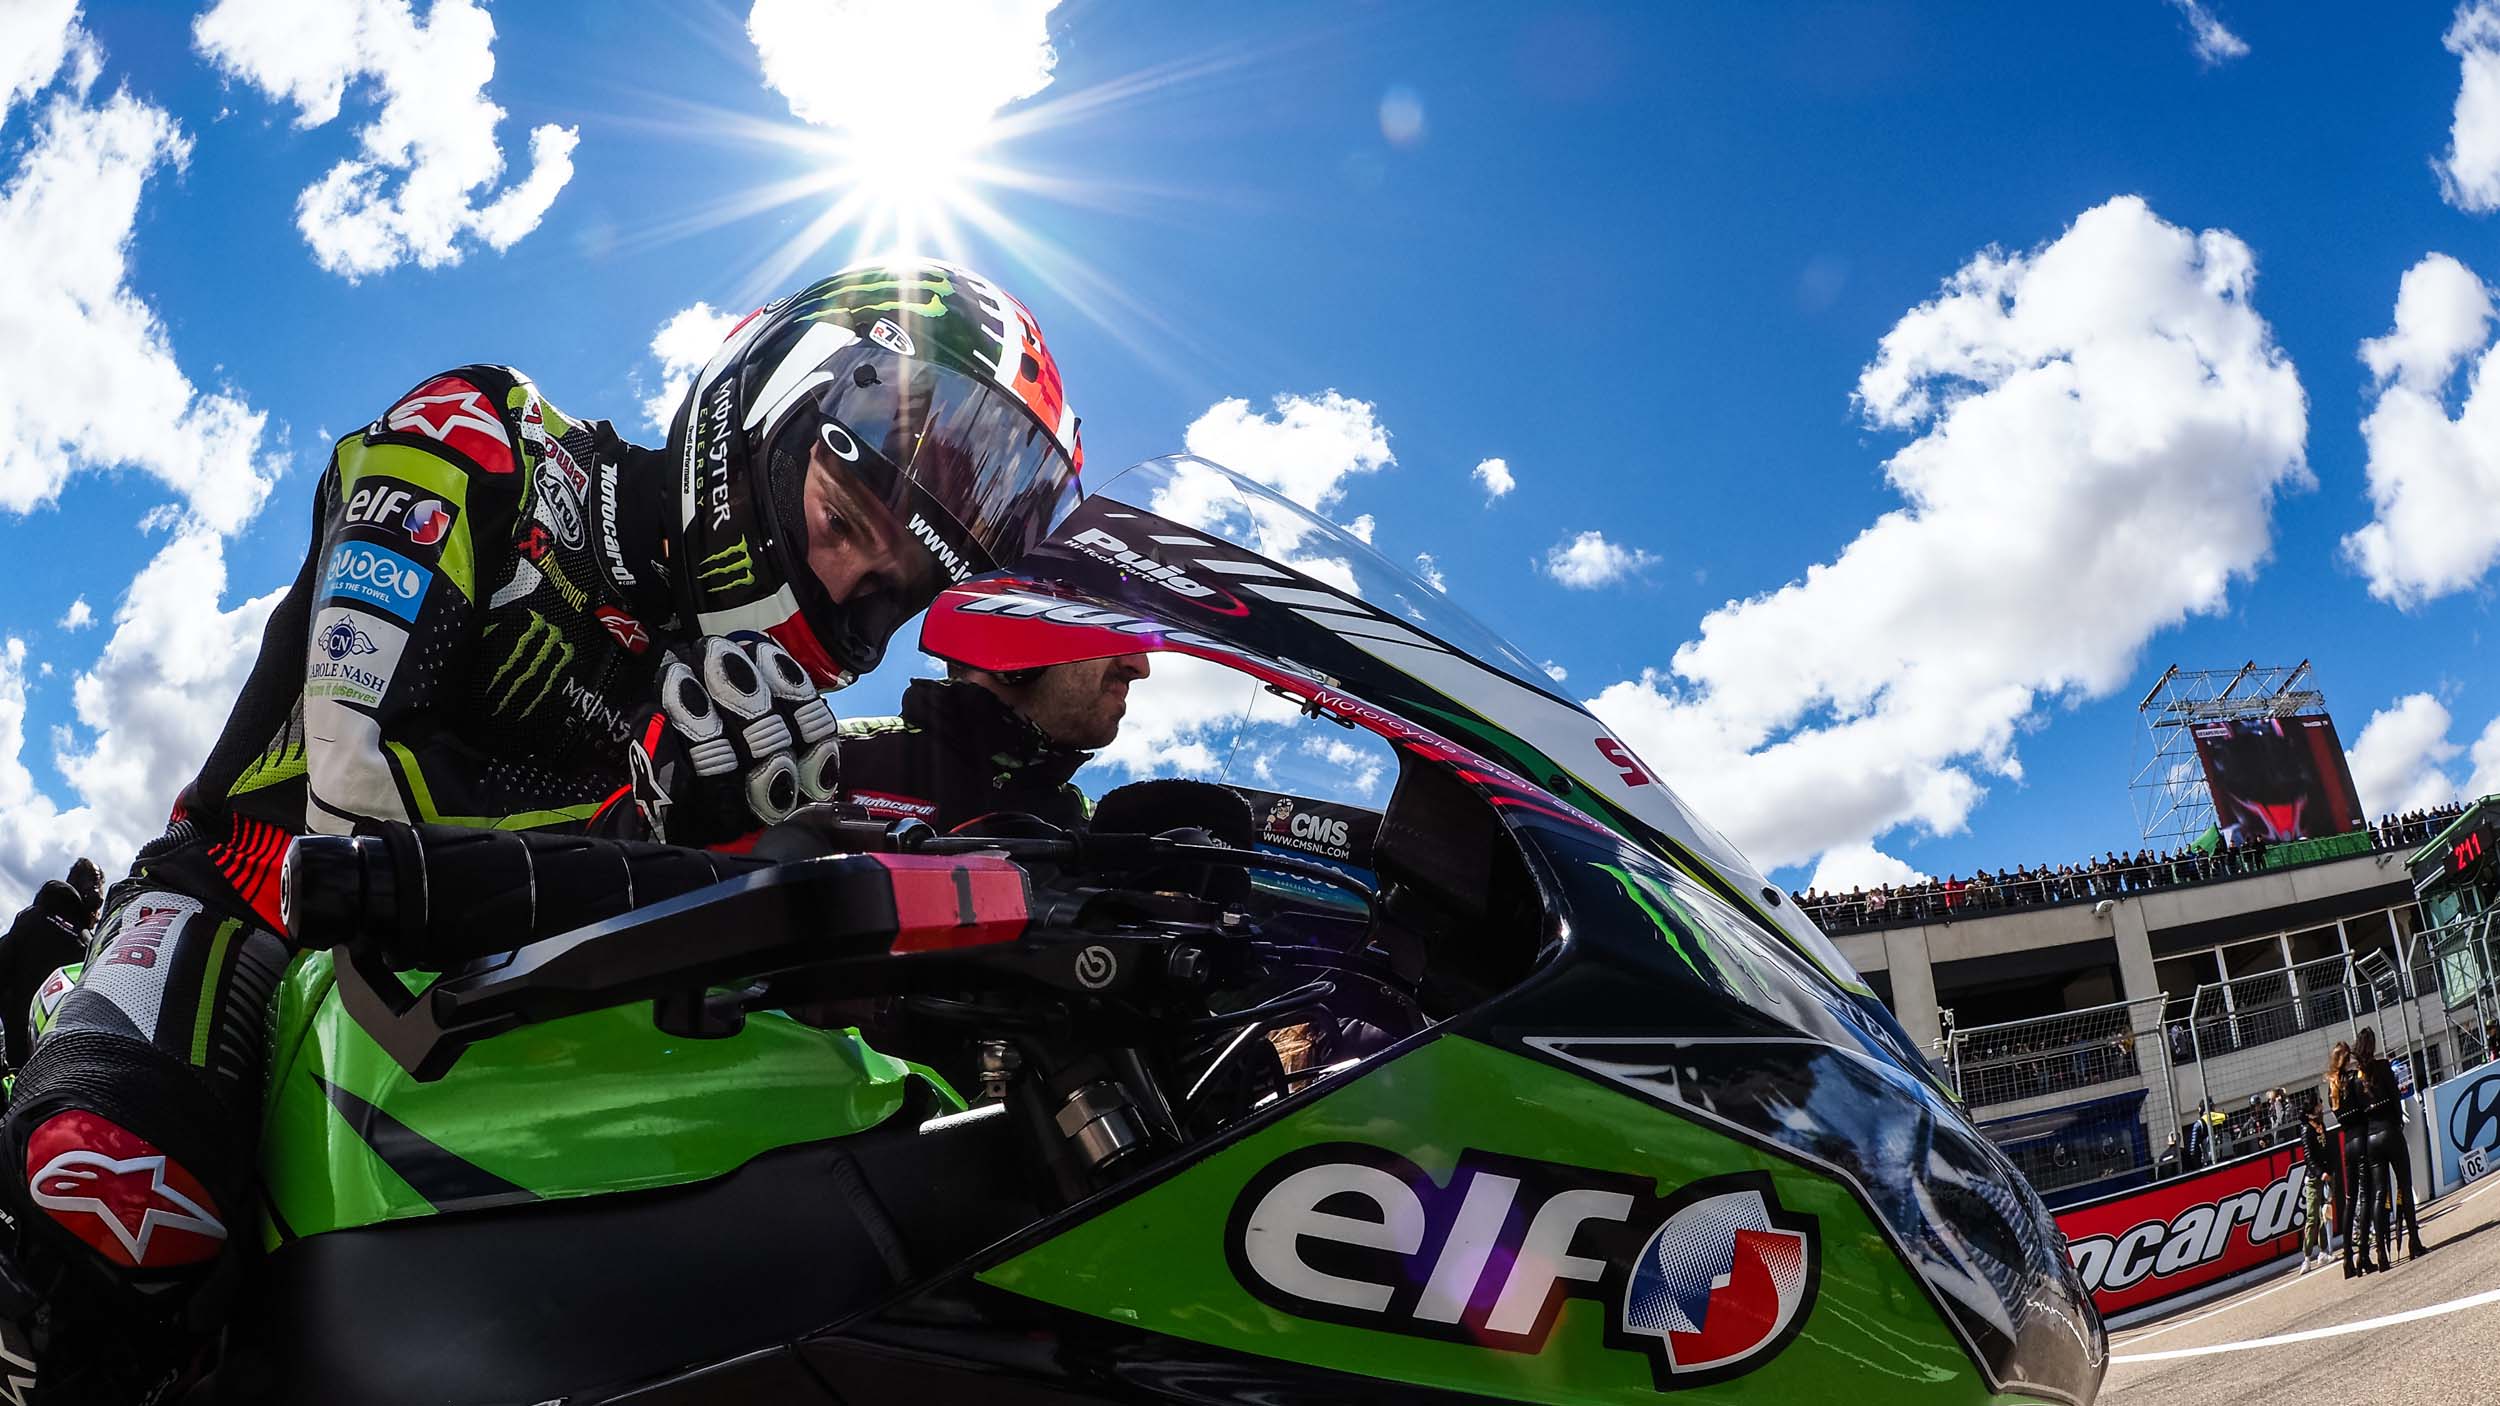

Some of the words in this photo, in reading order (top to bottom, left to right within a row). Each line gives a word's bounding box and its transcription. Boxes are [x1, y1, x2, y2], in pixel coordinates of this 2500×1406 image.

[696, 407, 708, 507] ENERGY
[345, 485, 412, 524] elf
[1064, 539, 1116, 565] Hi-Tech
[1116, 562, 1156, 583] Parts
[1072, 527, 1217, 598] Puig
[344, 582, 361, 592] THE
[361, 586, 391, 603] TOWEL
[330, 634, 350, 652] CN
[309, 663, 339, 679] AROLE
[339, 664, 386, 692] NASH
[1314, 691, 1456, 754] Motorcycle
[1263, 831, 1349, 860] WWW.CMSNL.COM
[1291, 813, 1349, 847] CMS
[1244, 1163, 1635, 1335] elf
